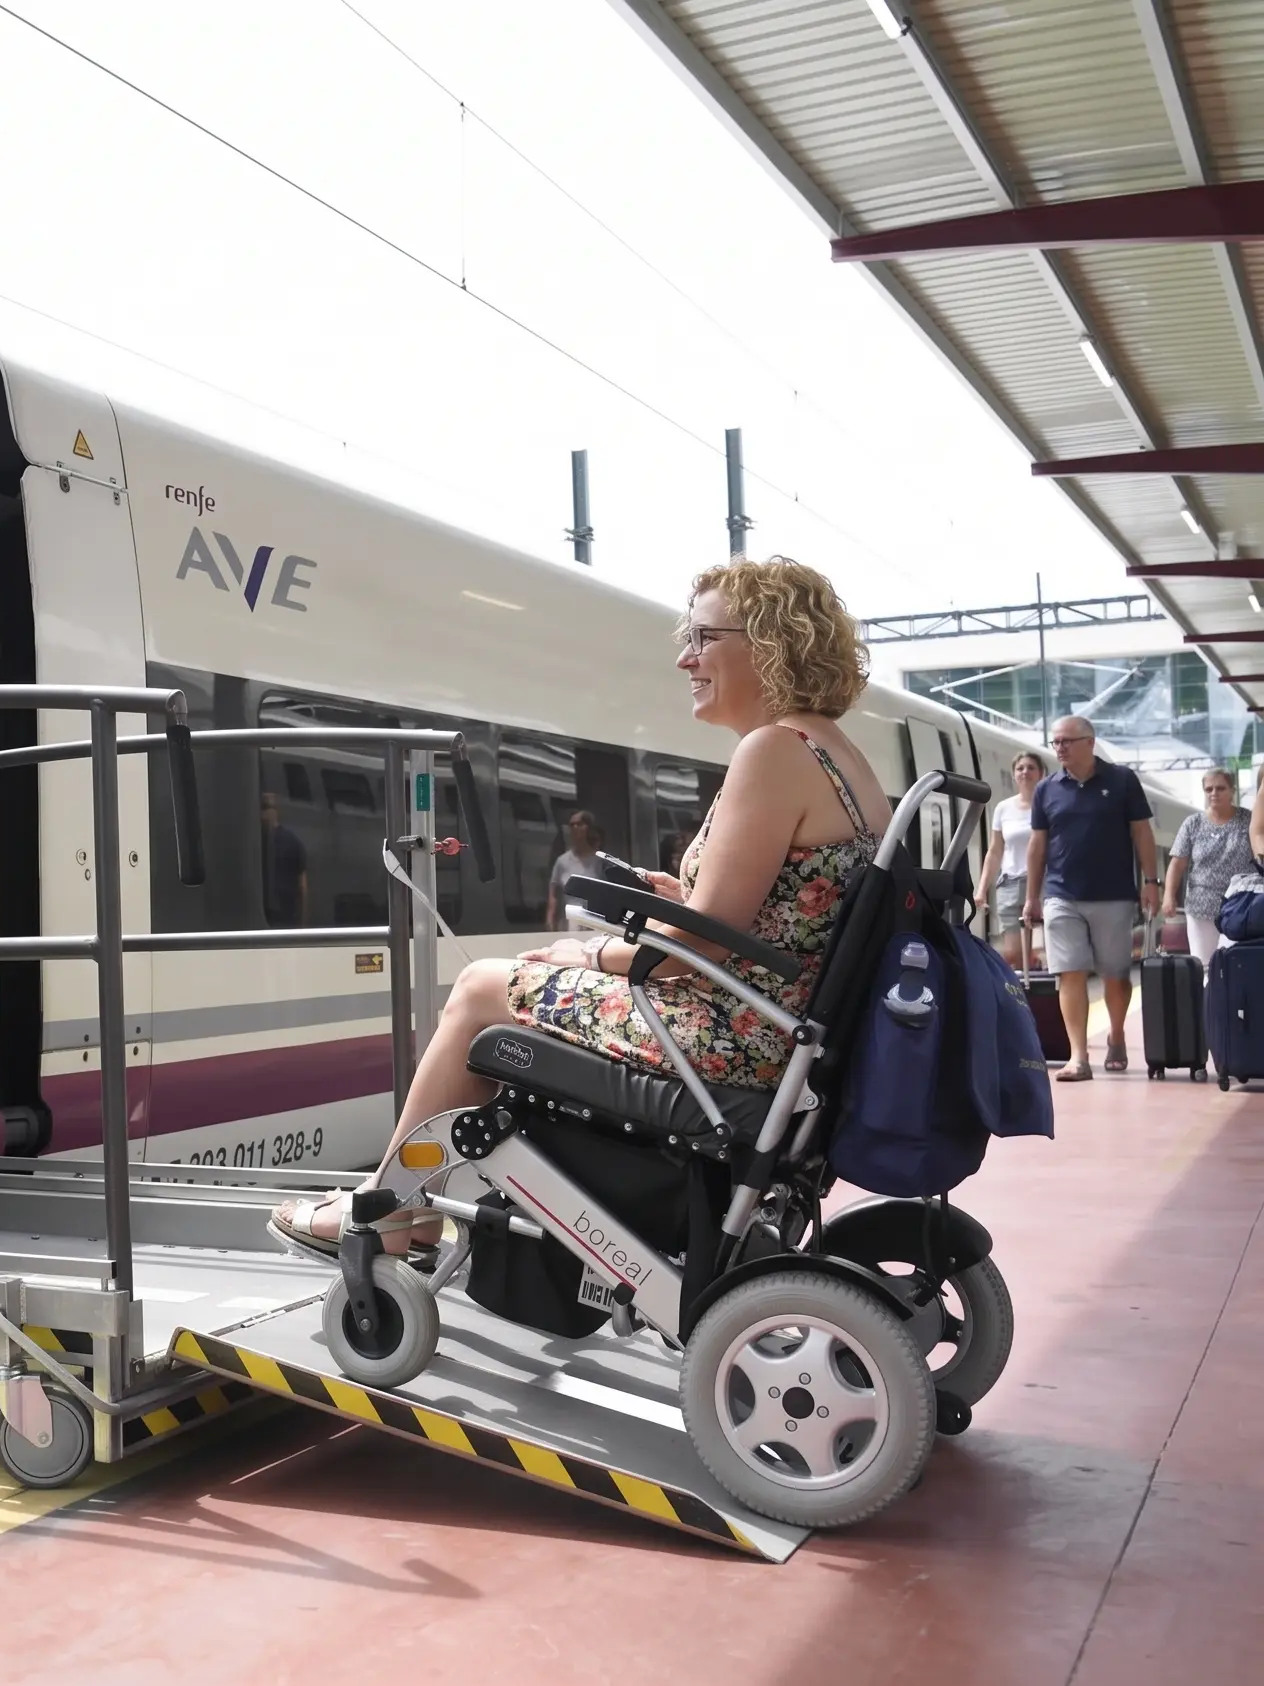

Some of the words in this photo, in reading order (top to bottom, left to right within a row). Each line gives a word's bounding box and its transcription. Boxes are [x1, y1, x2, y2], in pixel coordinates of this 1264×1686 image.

[165, 484, 216, 516] renfe
[176, 526, 318, 613] AVE
[234, 1138, 265, 1168] 011
[271, 1127, 323, 1166] 328-9
[572, 1209, 653, 1287] boreal
